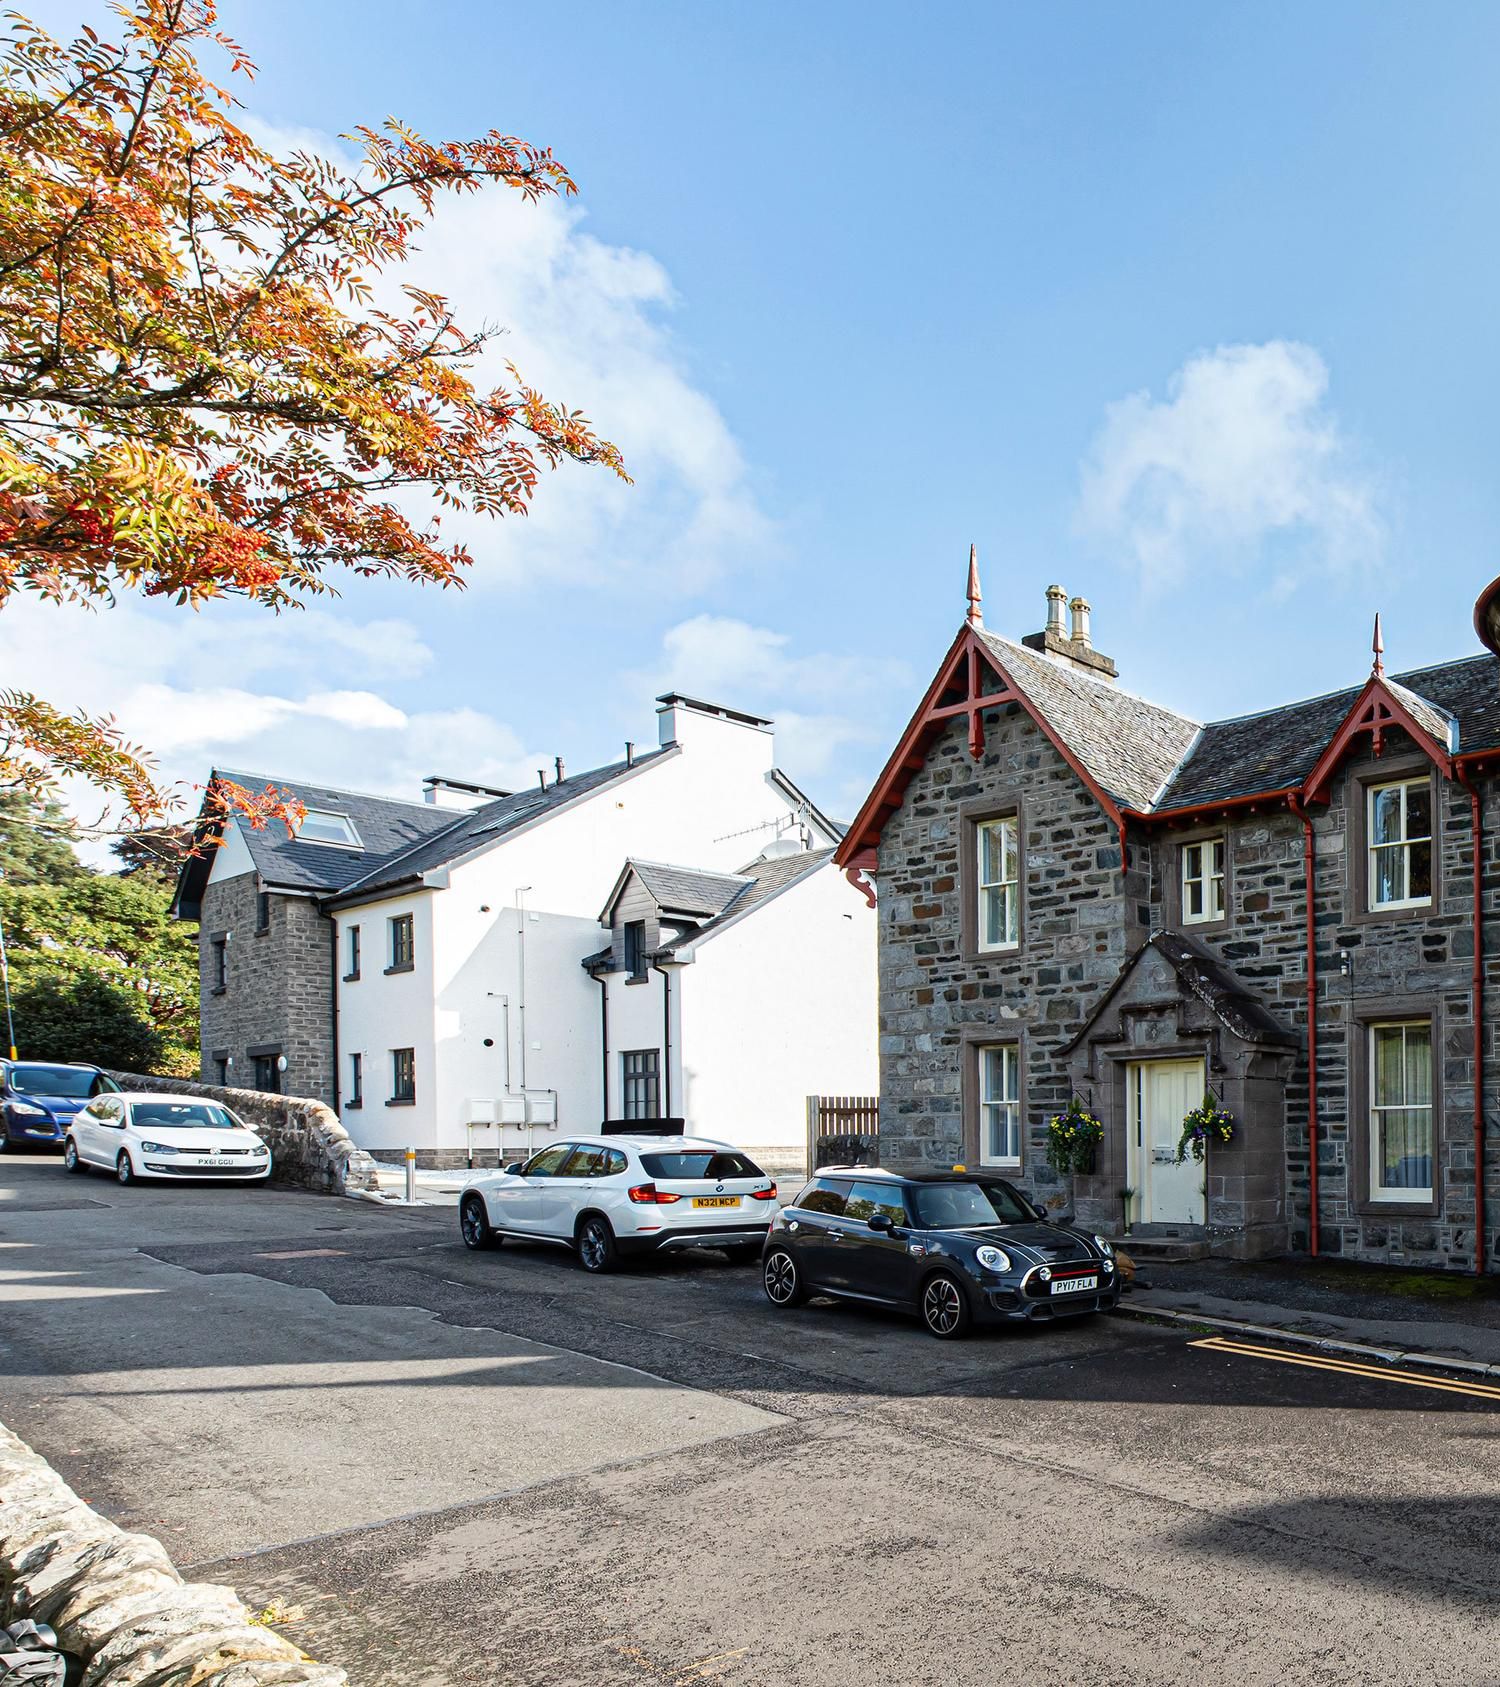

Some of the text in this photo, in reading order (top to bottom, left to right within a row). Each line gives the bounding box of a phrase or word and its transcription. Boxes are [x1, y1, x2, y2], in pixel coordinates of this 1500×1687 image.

[697, 1198, 718, 1207] N321
[1056, 1278, 1093, 1292] PY17 FLA
